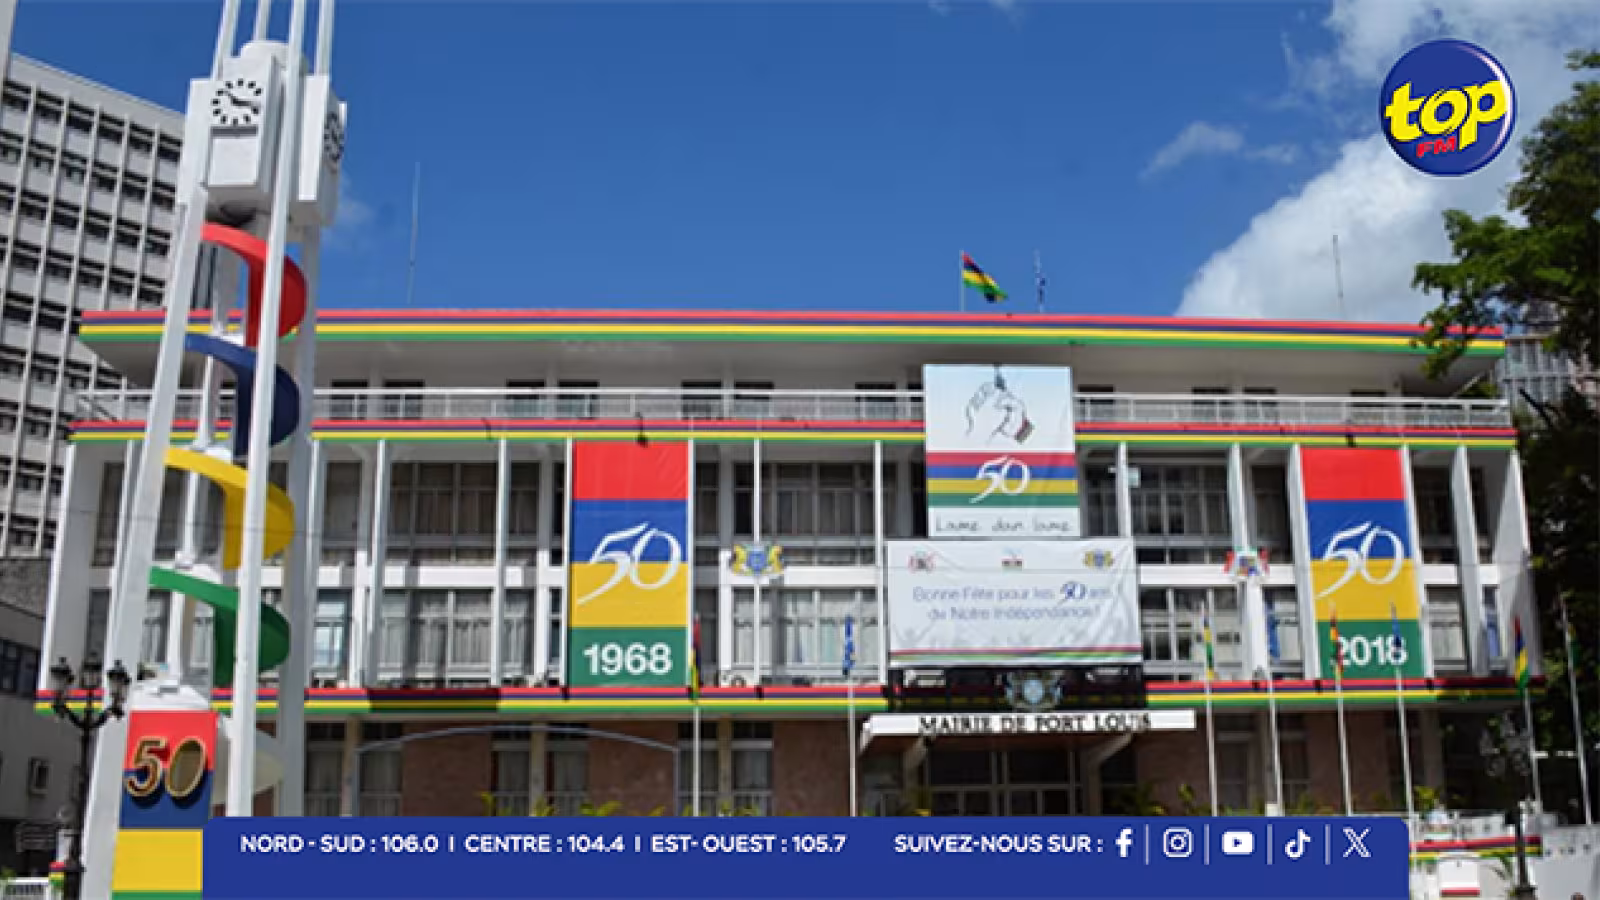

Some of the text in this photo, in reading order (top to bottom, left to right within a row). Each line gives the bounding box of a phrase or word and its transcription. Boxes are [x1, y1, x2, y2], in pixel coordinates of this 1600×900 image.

[968, 455, 1031, 504] 50
[577, 521, 682, 606] 50
[1314, 520, 1405, 600] 50
[912, 586, 960, 601] Bonne
[998, 589, 1028, 603] pour
[1058, 581, 1088, 606] 50
[583, 641, 673, 676] 1968
[1329, 634, 1409, 666] 2018
[918, 713, 1152, 735] MAIRIE DE PORT LOUIS
[123, 736, 208, 797] 50
